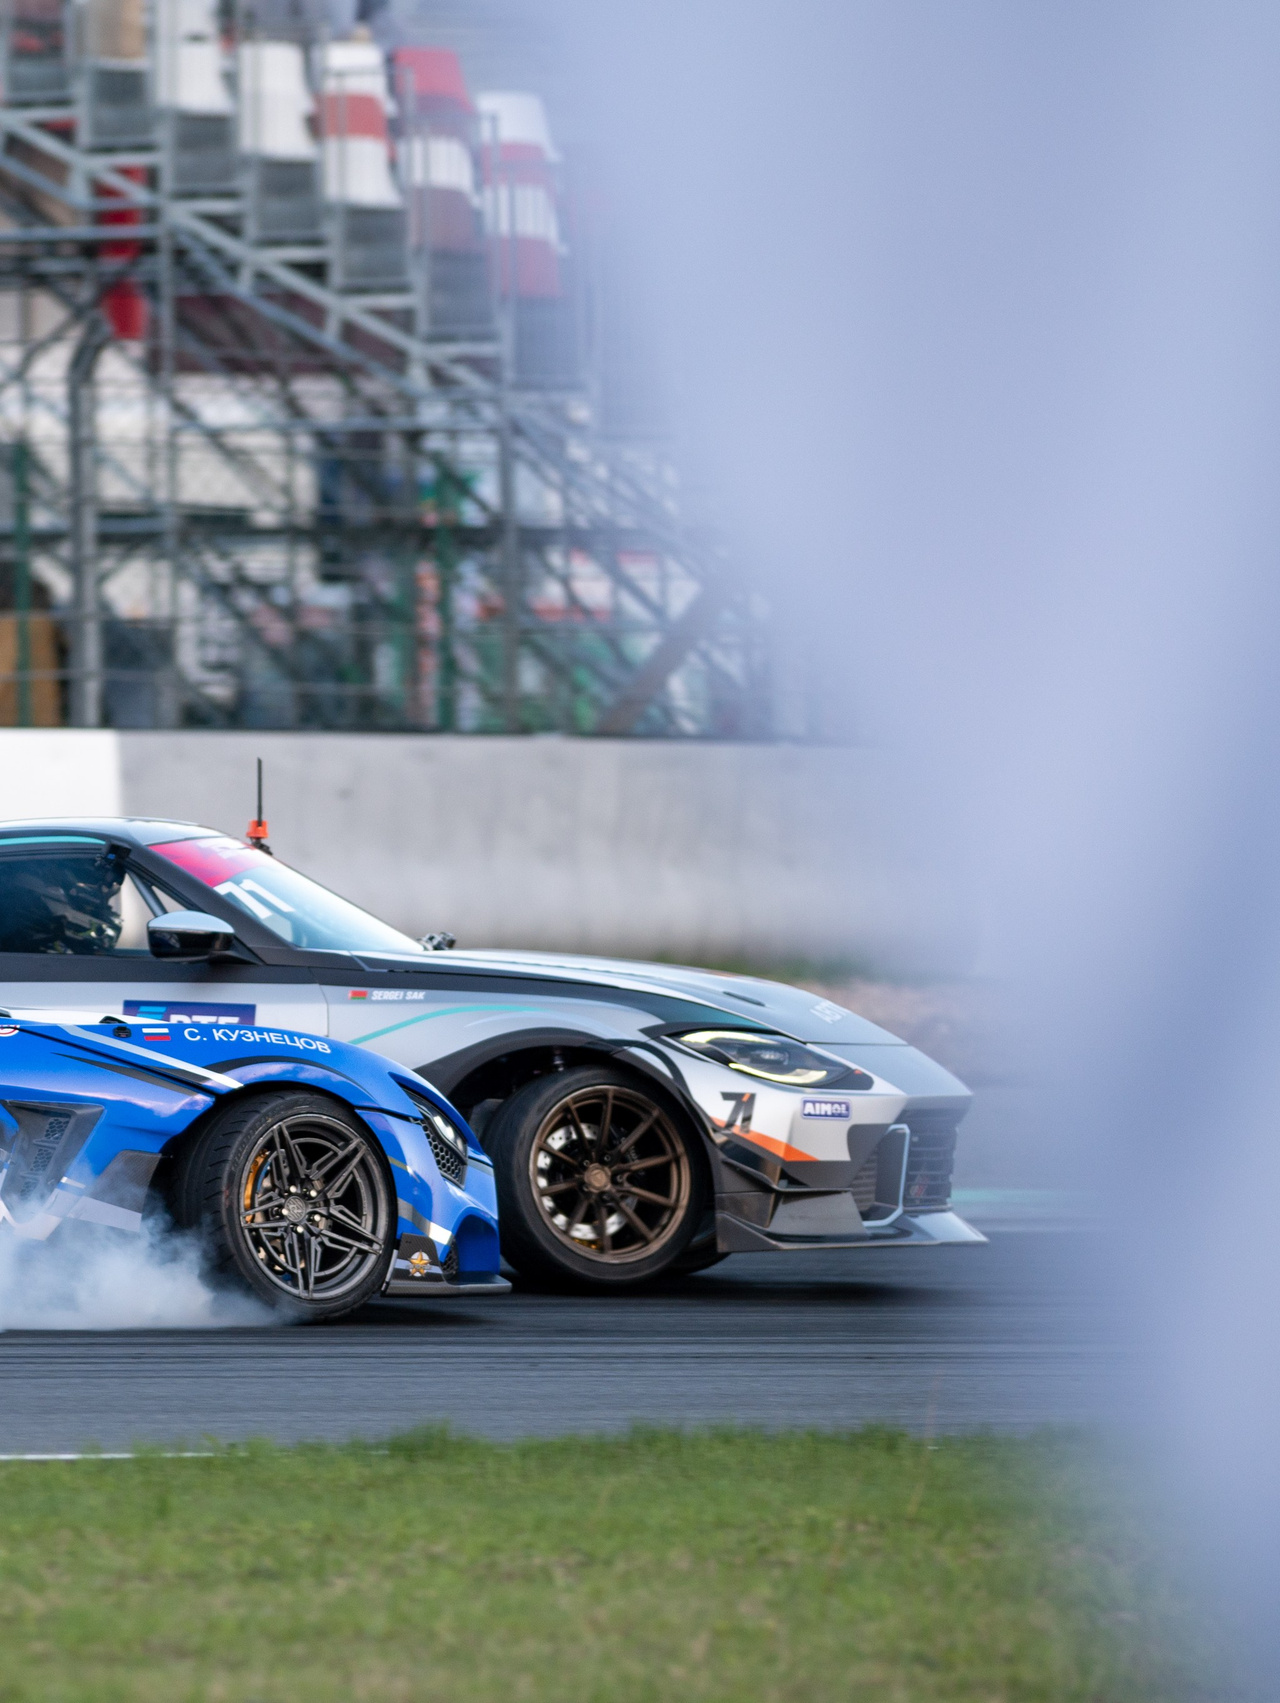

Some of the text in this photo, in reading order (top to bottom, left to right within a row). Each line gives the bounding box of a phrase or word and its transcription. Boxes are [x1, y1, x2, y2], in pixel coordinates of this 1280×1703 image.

[213, 879, 296, 919] 71
[371, 990, 426, 1001] SERGEI SAK
[183, 1027, 331, 1054] С. КУЗНЕЦОВ
[803, 1102, 849, 1115] AIMOL
